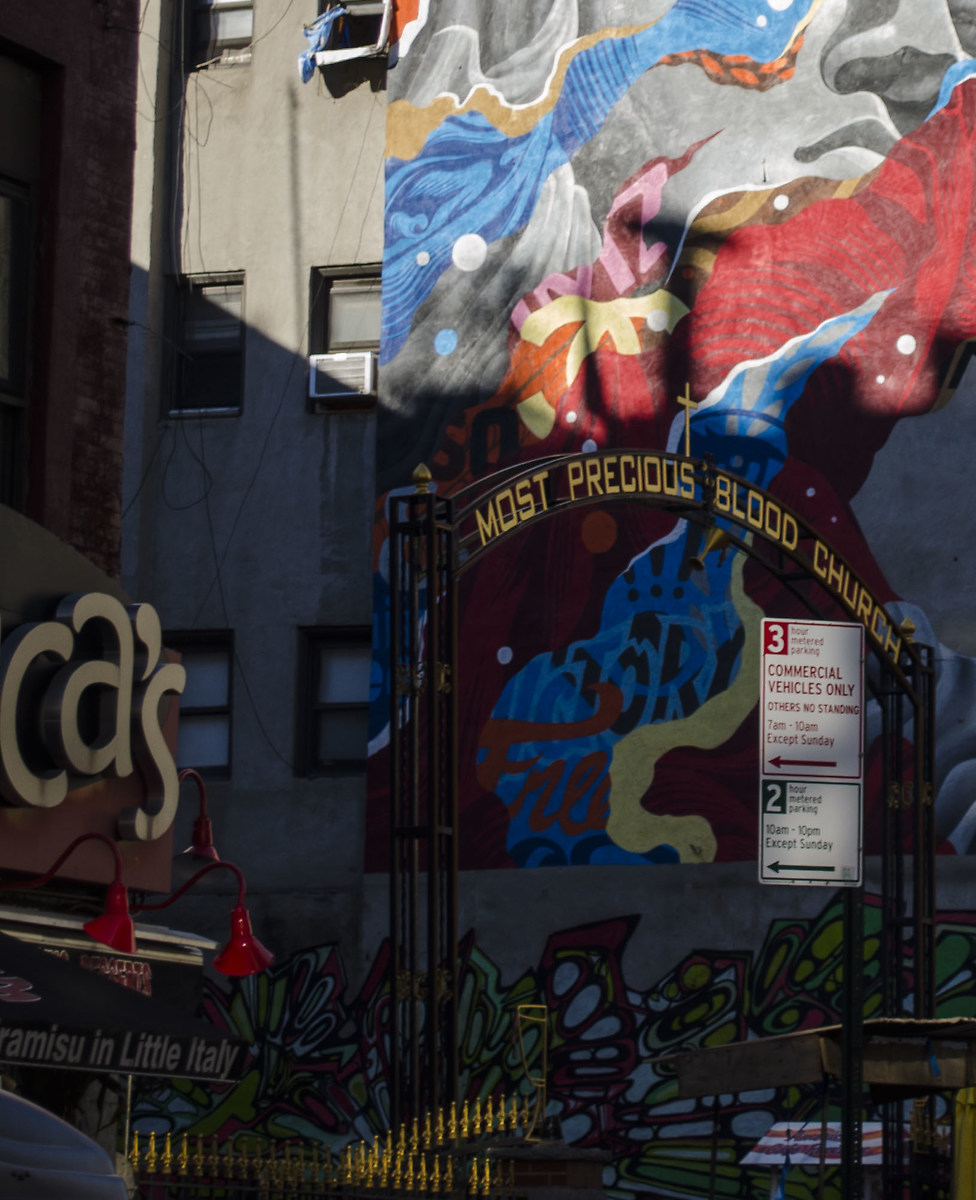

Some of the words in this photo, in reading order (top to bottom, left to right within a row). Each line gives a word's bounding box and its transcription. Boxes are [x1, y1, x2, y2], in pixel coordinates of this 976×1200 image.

[475, 471, 550, 546] MOST
[567, 455, 696, 501] PRECIOUS
[713, 474, 799, 552] BLOOD
[812, 539, 901, 664] CHURCH
[790, 626, 809, 635] hour
[766, 623, 785, 654] 3
[790, 637, 824, 646] metered
[790, 647, 820, 657] parking
[768, 664, 843, 680] COMMERCIAL
[768, 680, 822, 695] VEHICLES
[826, 683, 856, 697] ONLY
[767, 701, 801, 712] OTHERS
[803, 702, 816, 713] NO
[818, 703, 861, 715] STANDING
[767, 719, 787, 731] 7am
[795, 721, 819, 732] 10am
[767, 732, 799, 745] Except
[801, 734, 835, 748] Sunday
[789, 784, 807, 794] hour
[765, 783, 783, 813] 2
[789, 794, 823, 804] metered
[789, 804, 818, 815] parking
[766, 824, 789, 835] 10am
[798, 825, 821, 837] 10pm
[765, 837, 797, 850] Except
[800, 838, 834, 852] Sunday
[89, 1028, 115, 1066] in
[119, 1031, 182, 1071] Little
[185, 1035, 240, 1080] Italy
